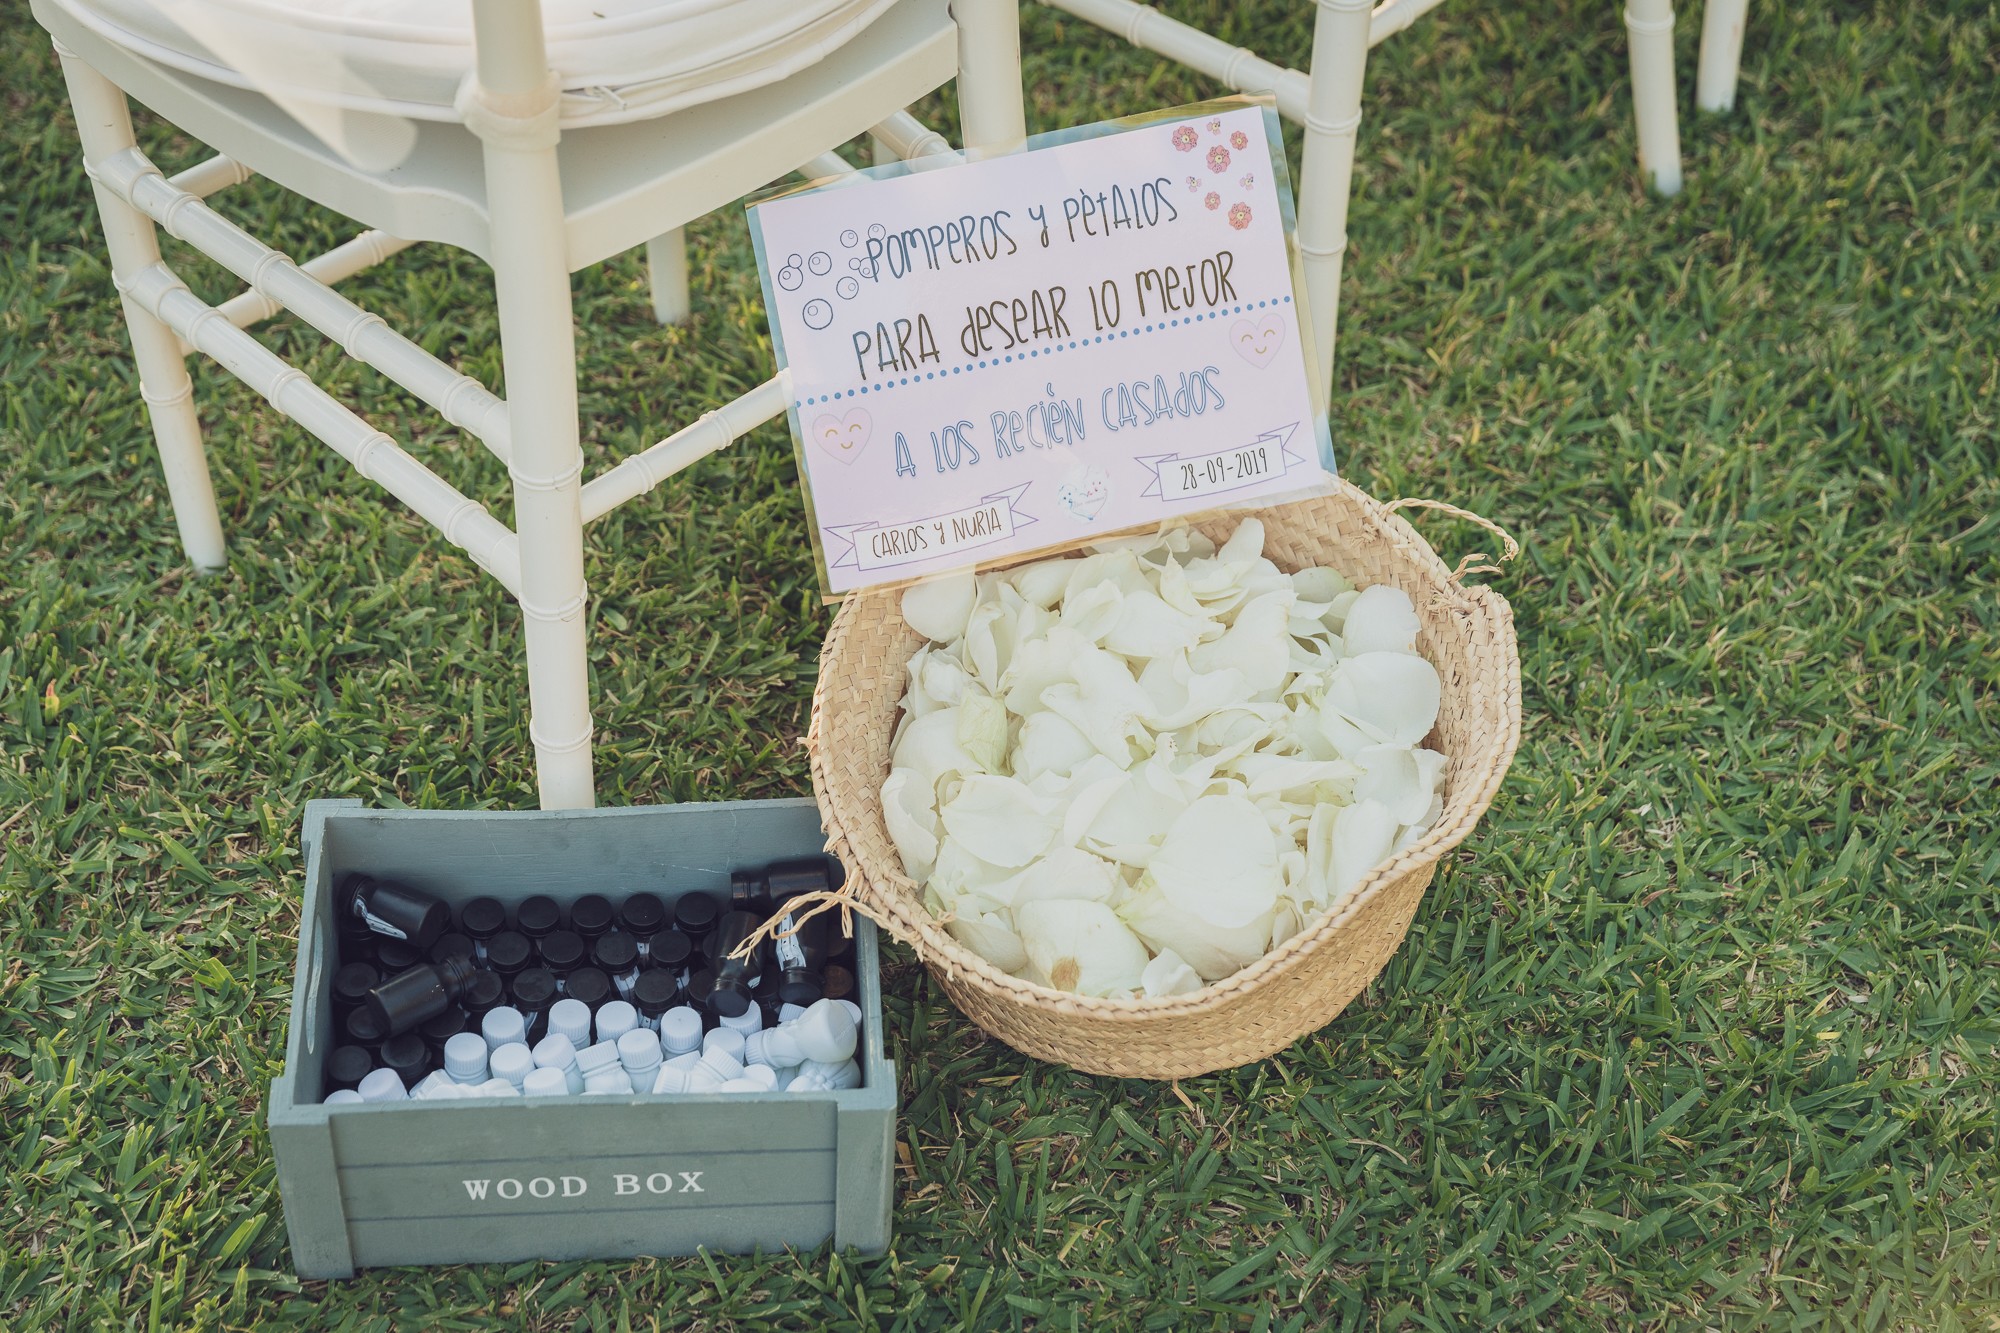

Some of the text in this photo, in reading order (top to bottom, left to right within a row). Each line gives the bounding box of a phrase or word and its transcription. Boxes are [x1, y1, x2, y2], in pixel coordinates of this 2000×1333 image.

[852, 313, 941, 381] PARA
[894, 431, 916, 477] A
[1179, 446, 1269, 492] 28-09-2019
[461, 1171, 705, 1201] WOOD BOX
